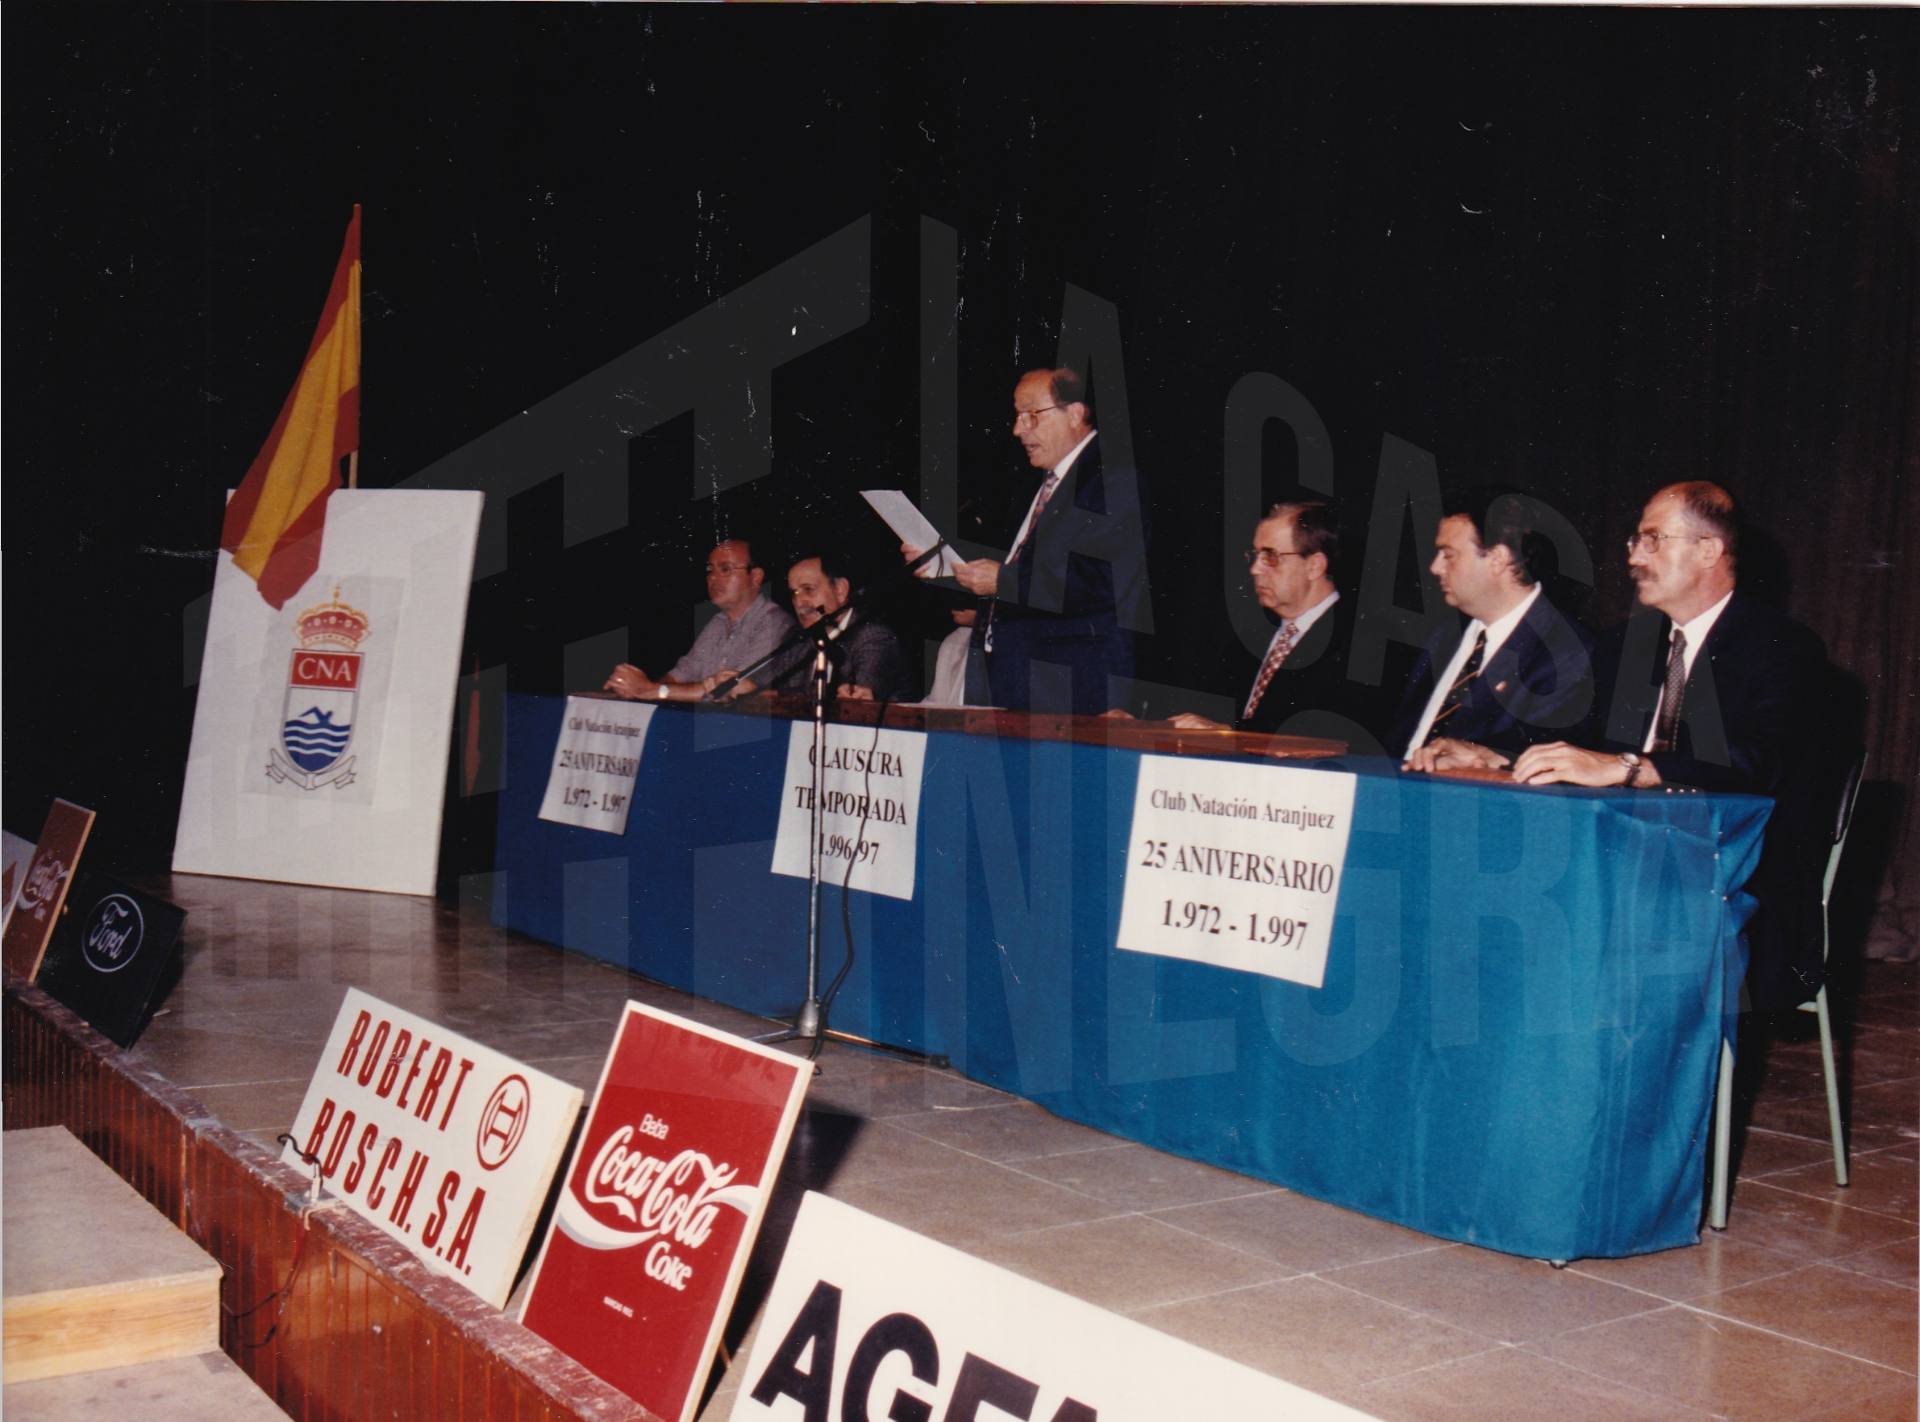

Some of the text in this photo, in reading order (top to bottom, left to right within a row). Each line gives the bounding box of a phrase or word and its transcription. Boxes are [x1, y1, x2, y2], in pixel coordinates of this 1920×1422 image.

[298, 657, 352, 682] CNA
[1150, 788, 1336, 831] Club Natación Aranjuez
[819, 832, 880, 865] 1.99697
[1141, 839, 1335, 894] 25 ANIVERSARIO
[88, 900, 134, 960] Ford
[1162, 899, 1222, 935] 1.972
[1247, 912, 1308, 950] 1.997
[336, 1009, 475, 1132] ROBERT
[639, 1113, 669, 1140] Beba
[644, 1240, 693, 1292] Coke
[750, 1279, 1098, 1422] AG
